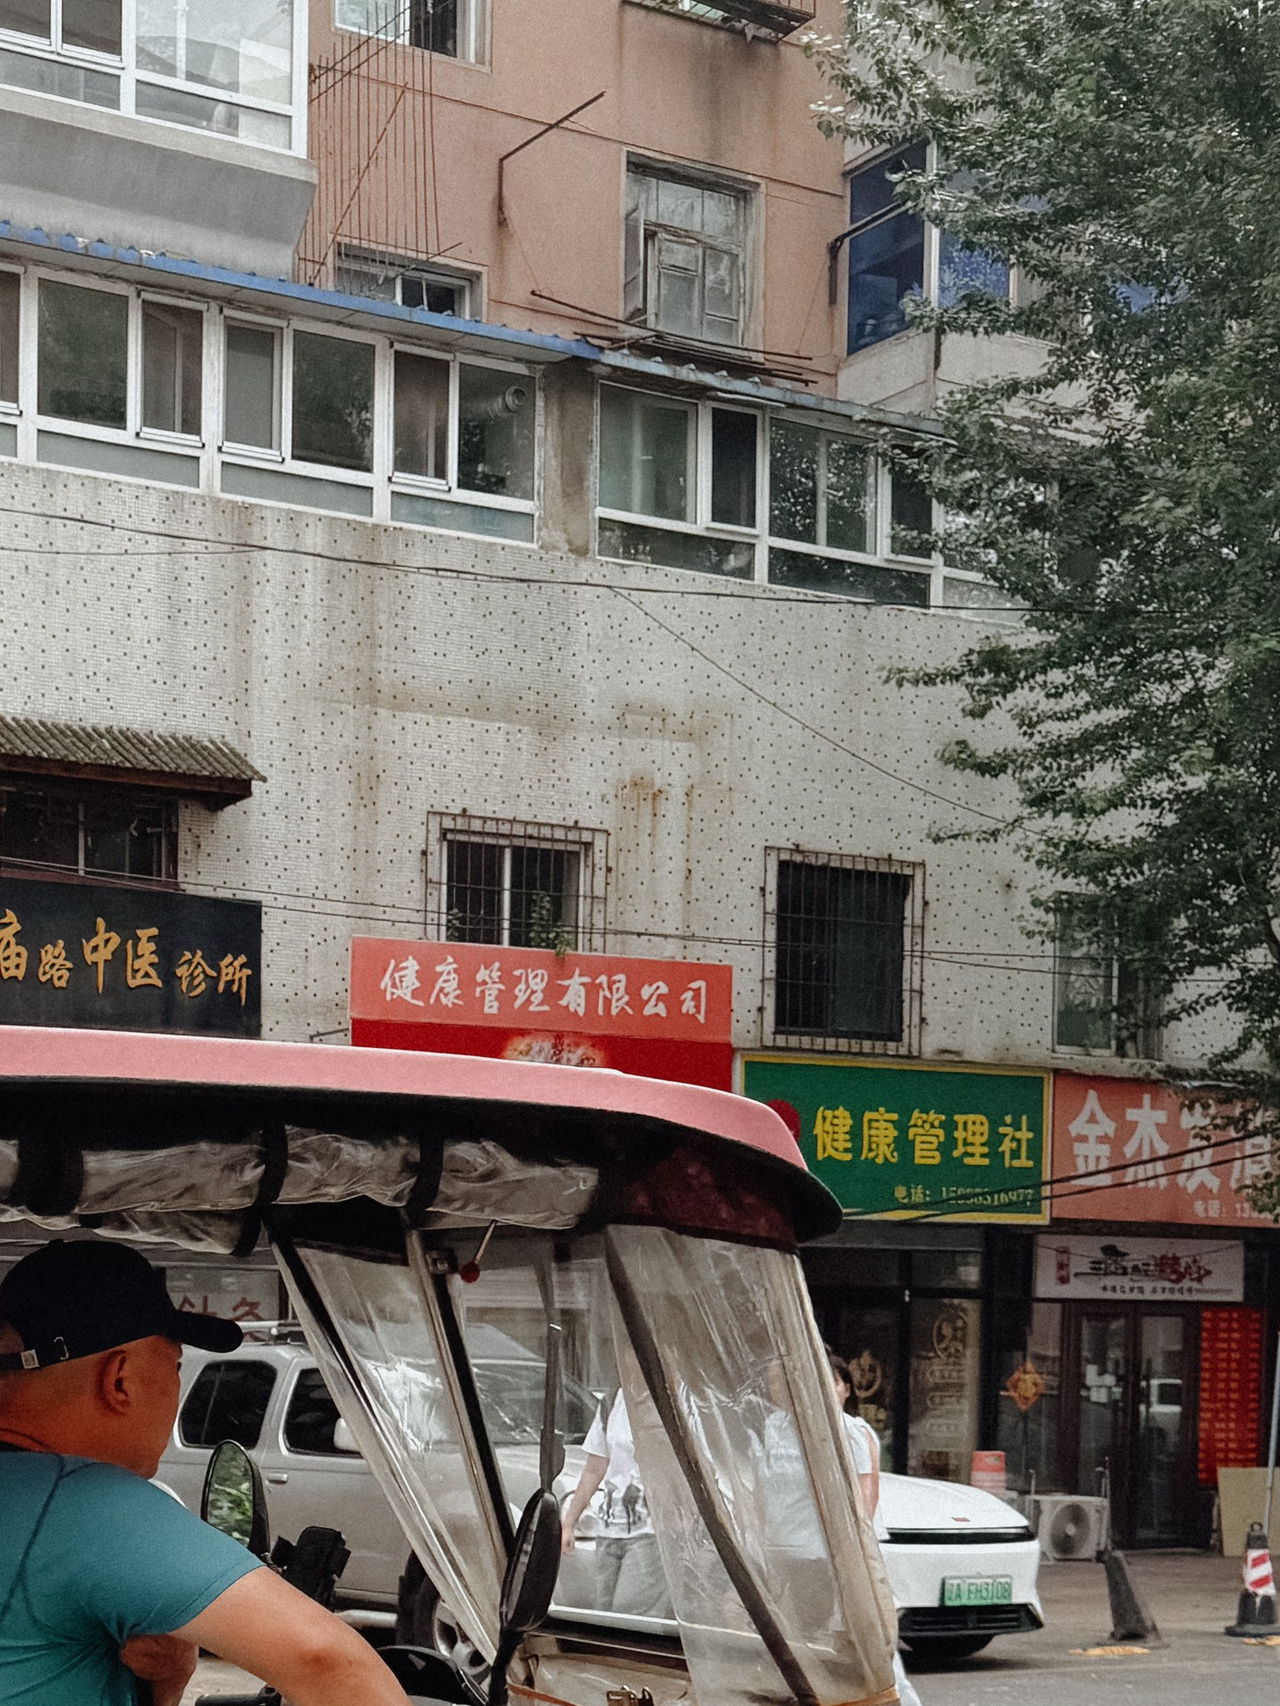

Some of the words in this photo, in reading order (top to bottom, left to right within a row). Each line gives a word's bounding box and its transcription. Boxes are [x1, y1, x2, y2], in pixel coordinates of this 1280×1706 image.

[380, 955, 707, 1024] 健康管理有限公司
[813, 1106, 1034, 1168] 健康管理社
